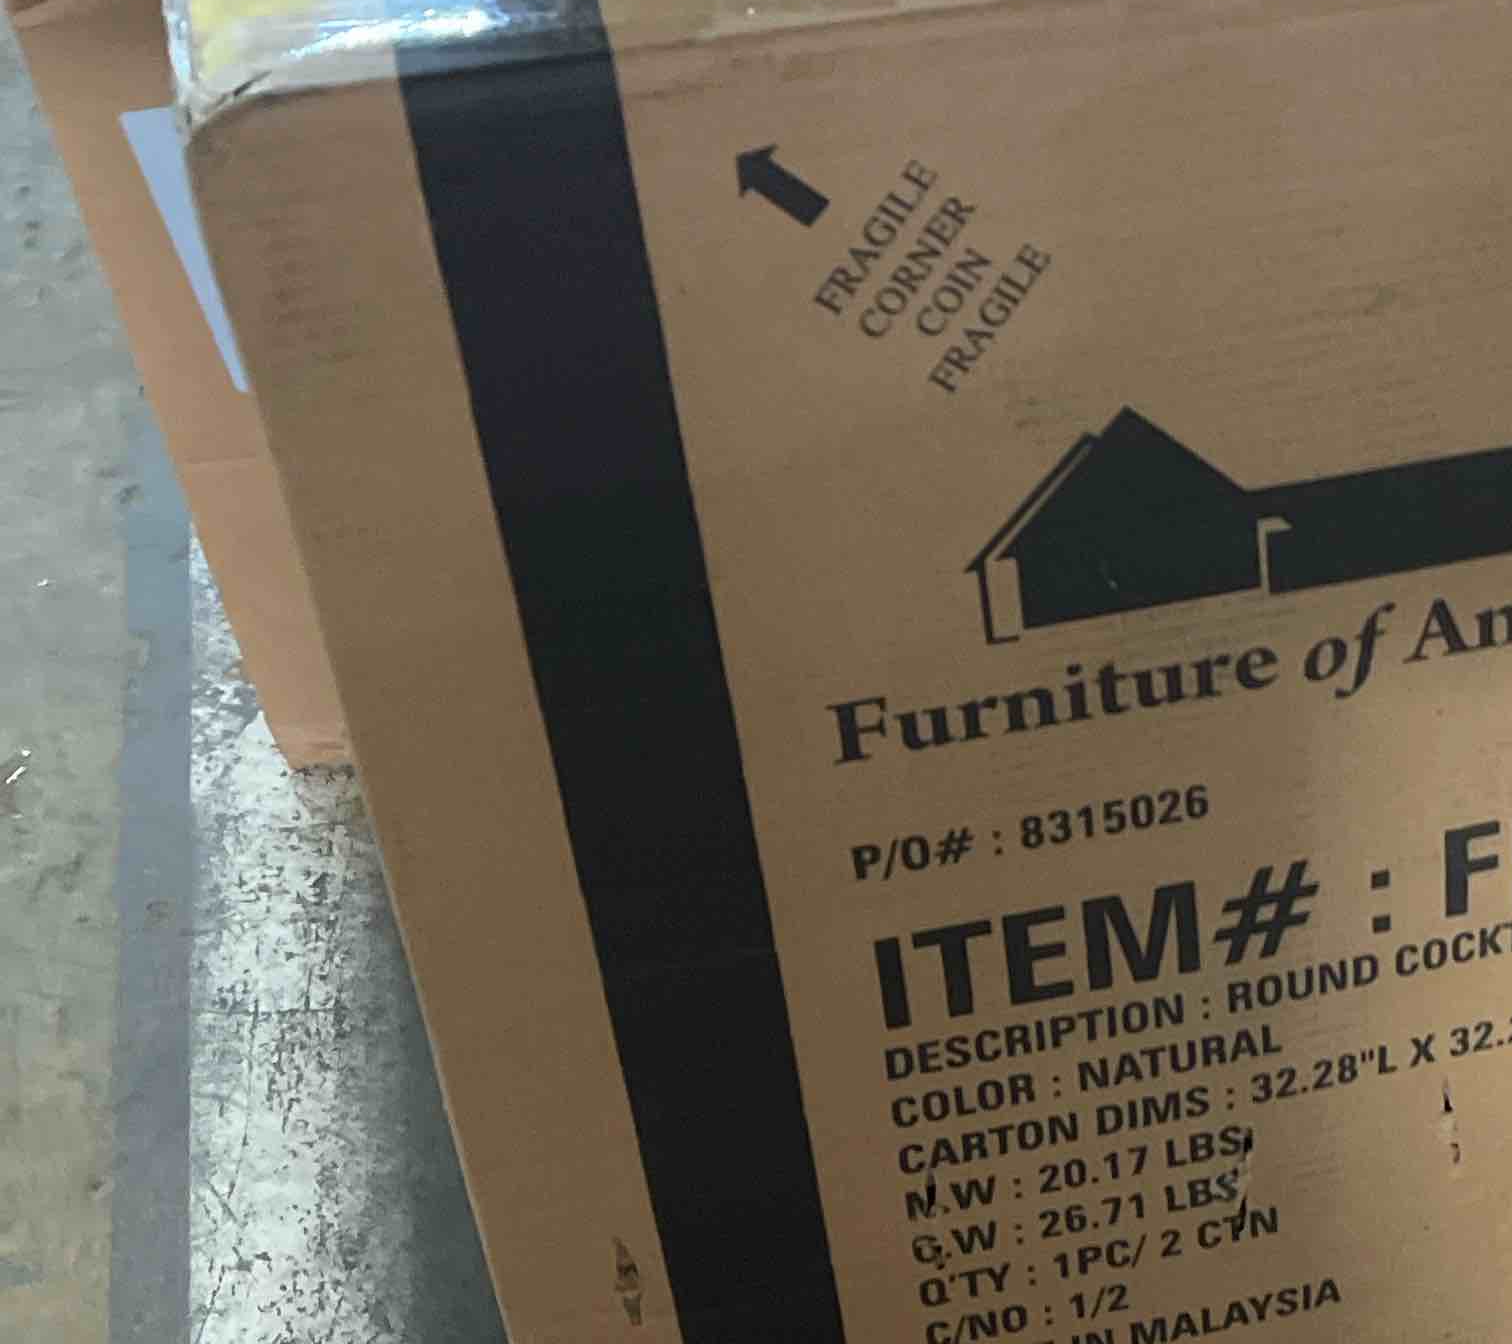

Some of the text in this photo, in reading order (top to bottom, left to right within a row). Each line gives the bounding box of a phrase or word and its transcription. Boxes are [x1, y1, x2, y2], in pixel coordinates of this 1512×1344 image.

[813, 159, 939, 317] FRAGILE
[859, 196, 978, 340] CORNER
[916, 247, 993, 337] COIN
[928, 243, 1053, 393] FRAGILE
[827, 646, 1280, 765] Furniture
[1302, 602, 1397, 699] of
[850, 826, 974, 882] P/O#
[1020, 784, 1210, 850] 8315026
[874, 859, 1319, 1030] ITEM#
[883, 993, 1186, 1081] DESCRIPTION
[1227, 953, 1380, 1014] ROUND
[891, 1072, 1036, 1129] COLOR
[1077, 1024, 1283, 1093] NATURAL
[898, 1110, 1080, 1175] CARTON
[1095, 1086, 1211, 1136] DIMS
[1251, 1046, 1397, 1106] 32.28"L
[1409, 1033, 1436, 1067] X
[1038, 1145, 1149, 1195] 20.17
[1164, 1126, 1242, 1168] LBS
[1038, 1193, 1145, 1241] 26.71
[1165, 1169, 1240, 1213] LBS
[918, 1261, 1012, 1308] Q'TY
[1053, 1234, 1148, 1281] 1PC/
[1160, 1229, 1183, 1258] 2
[1197, 1206, 1279, 1251] CTN
[1070, 1284, 1129, 1321] 1/2
